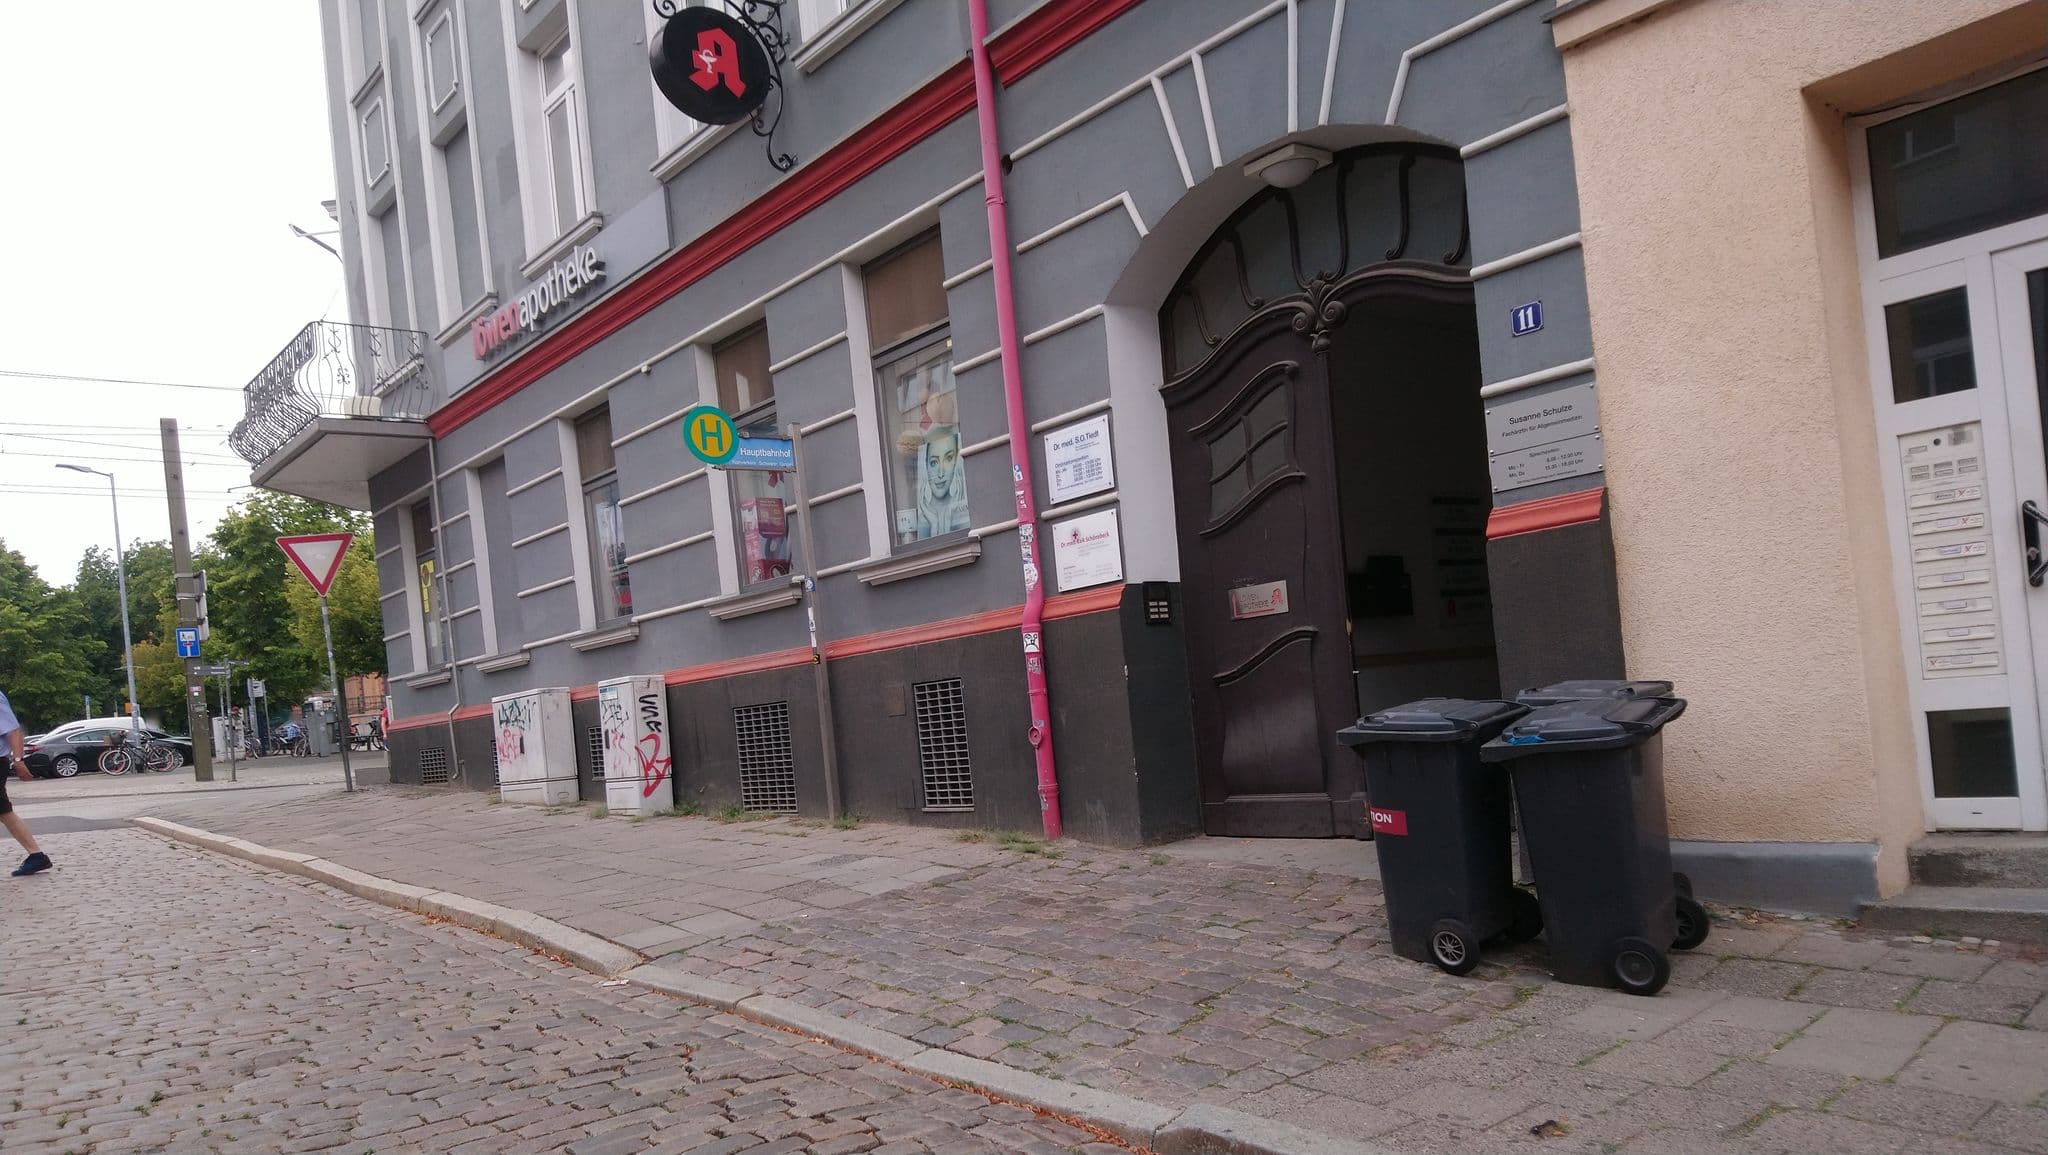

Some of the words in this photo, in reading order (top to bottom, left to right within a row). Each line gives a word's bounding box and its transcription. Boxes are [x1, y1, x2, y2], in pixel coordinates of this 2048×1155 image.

[1517, 306, 1536, 331] 11
[1509, 412, 1541, 425] Susanne
[1542, 404, 1573, 417] Schulze
[700, 418, 724, 452] H
[740, 447, 792, 458] Hauptbahnhof
